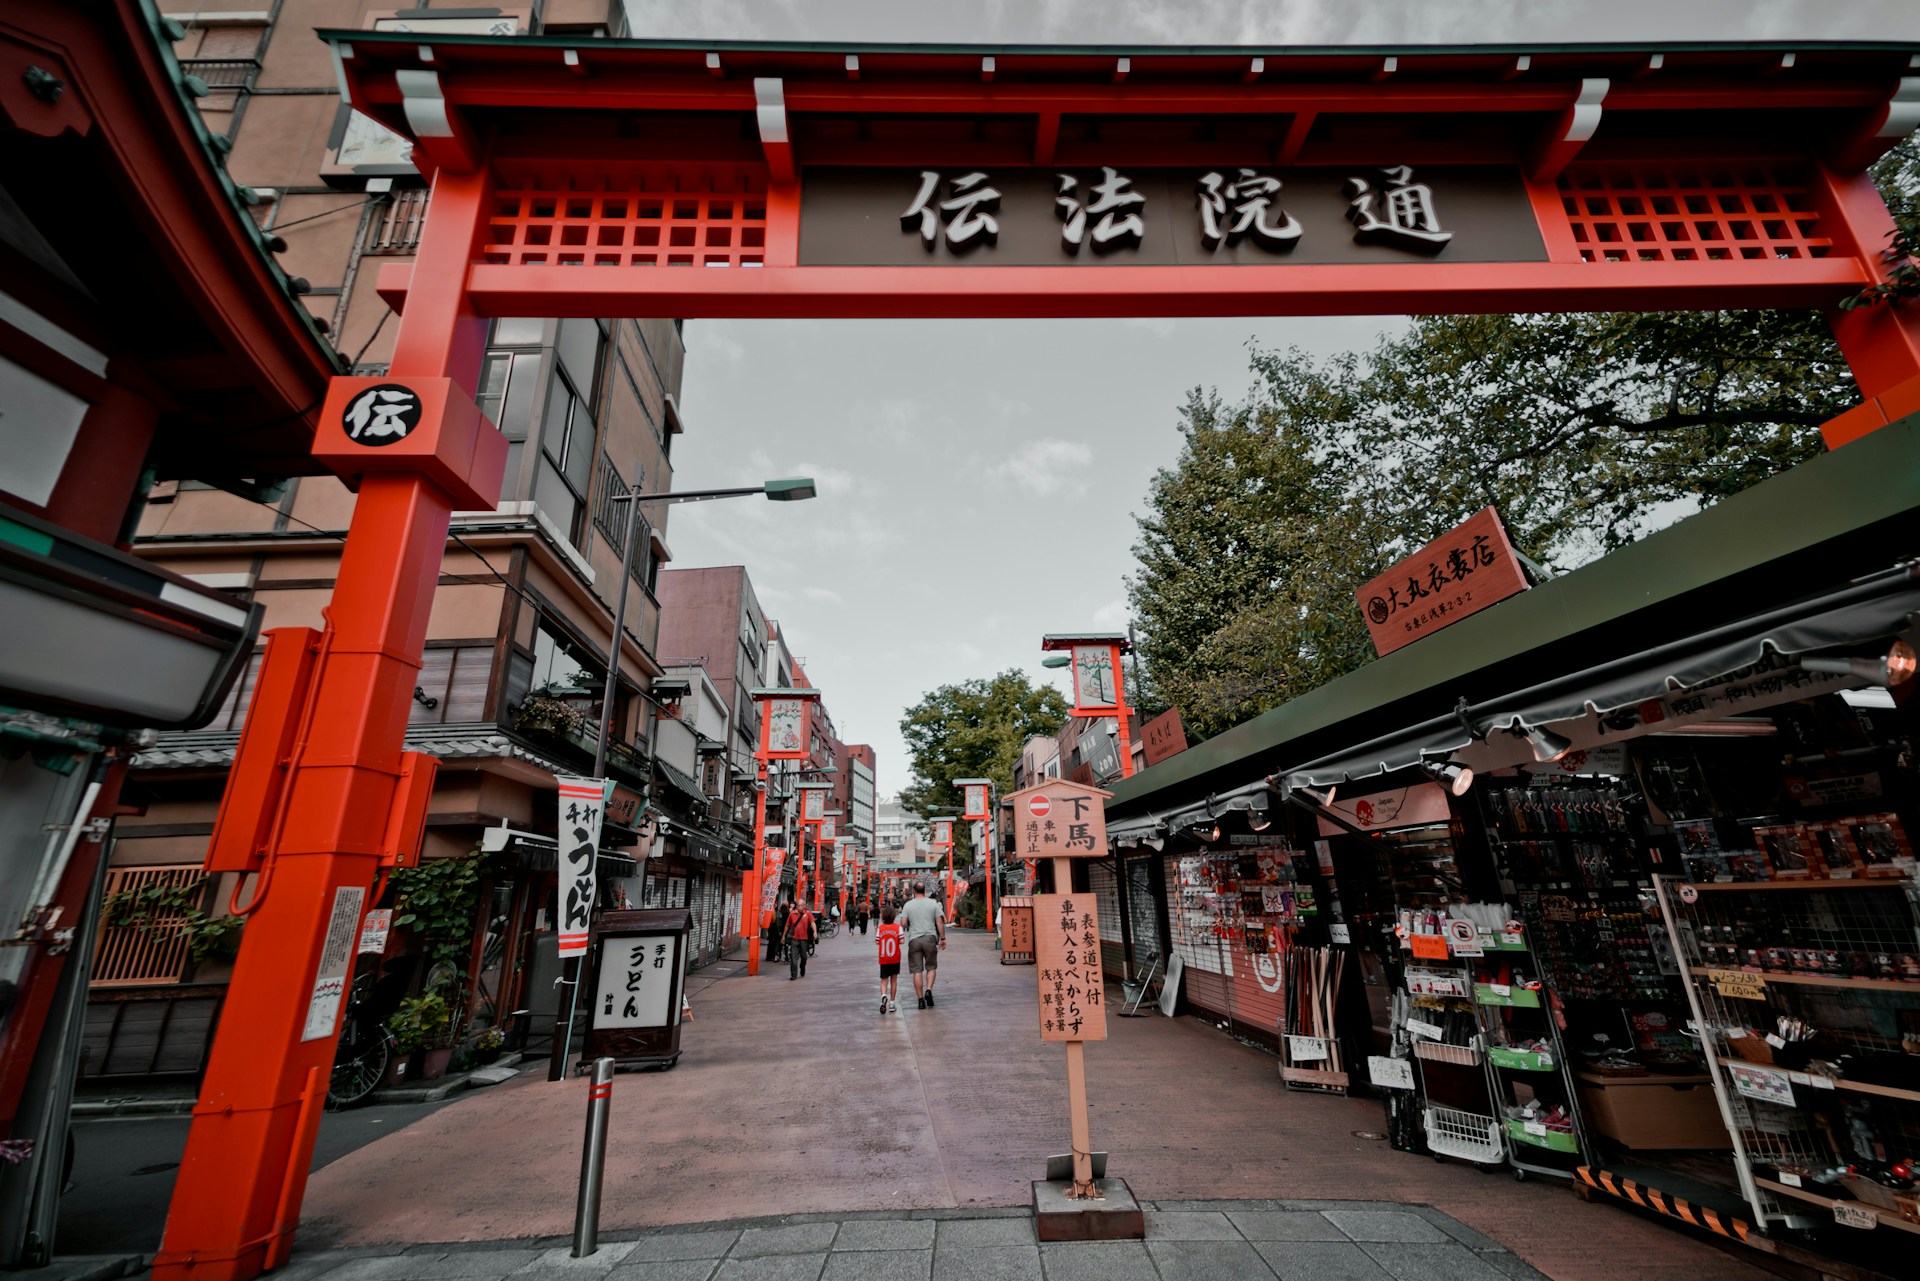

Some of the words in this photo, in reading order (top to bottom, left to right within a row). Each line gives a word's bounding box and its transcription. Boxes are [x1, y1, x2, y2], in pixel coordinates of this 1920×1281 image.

[900, 165, 1455, 252] 伝法院通
[345, 388, 414, 439] 伝
[565, 802, 599, 833] 手打
[1026, 821, 1041, 853] 通行止
[1062, 796, 1096, 851] 下馬
[565, 827, 596, 931] うどん
[653, 944, 667, 968] 手打
[880, 937, 896, 957] 10
[1081, 912, 1101, 1006] 表参道に付
[623, 945, 645, 1018] うどん
[1041, 968, 1055, 1032] 浅草寺
[1053, 968, 1067, 1032] 浅草警察署
